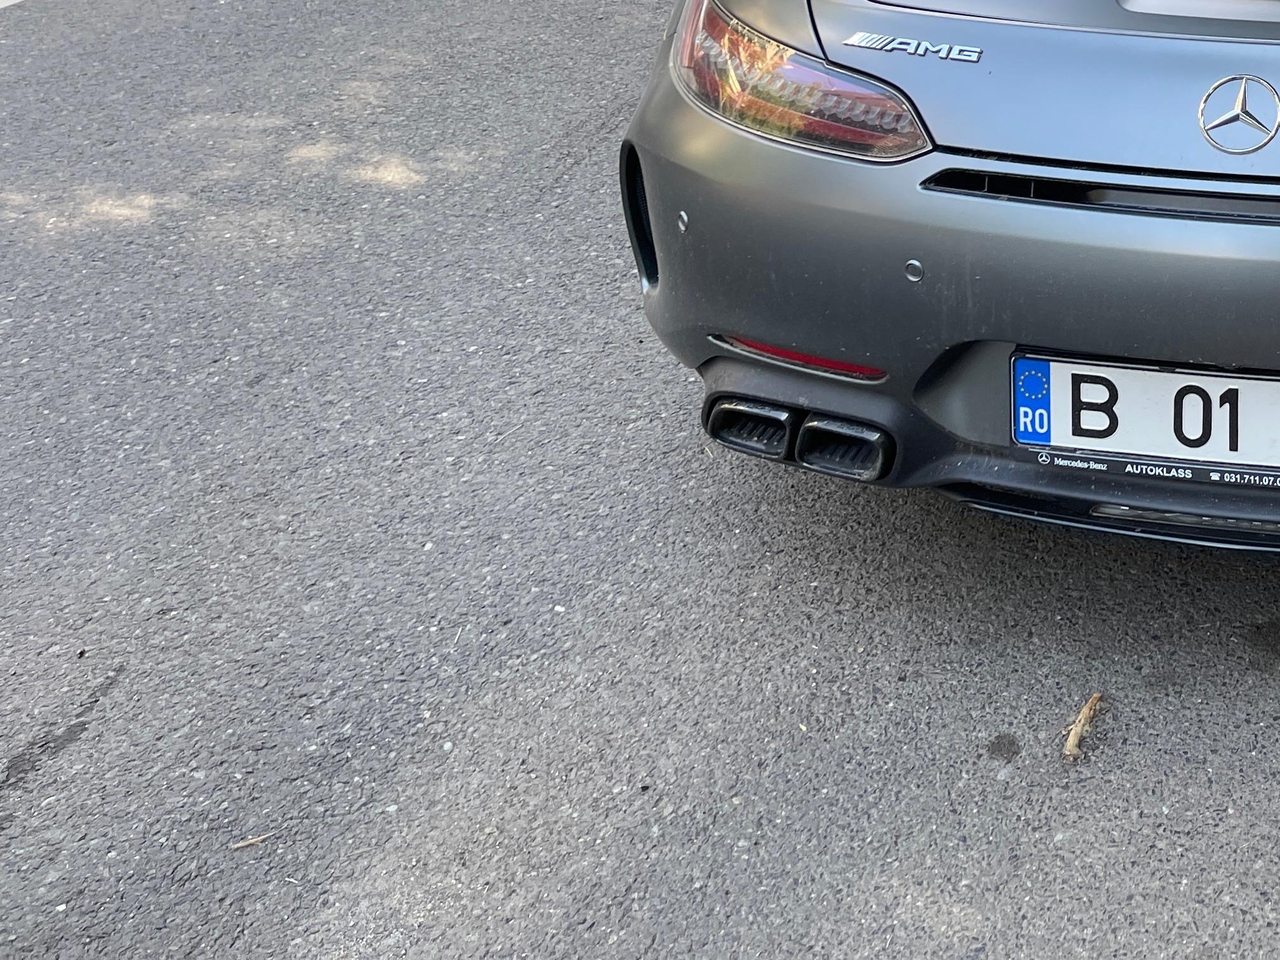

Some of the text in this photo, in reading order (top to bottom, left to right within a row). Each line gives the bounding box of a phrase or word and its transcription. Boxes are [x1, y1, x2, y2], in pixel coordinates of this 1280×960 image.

[883, 37, 983, 62] AMG
[1018, 406, 1049, 435] RO
[1071, 372, 1119, 439] B
[1173, 384, 1240, 452] 01
[1053, 457, 1108, 471] Mercedes-Benz
[1125, 463, 1193, 479] AUTOKLASS
